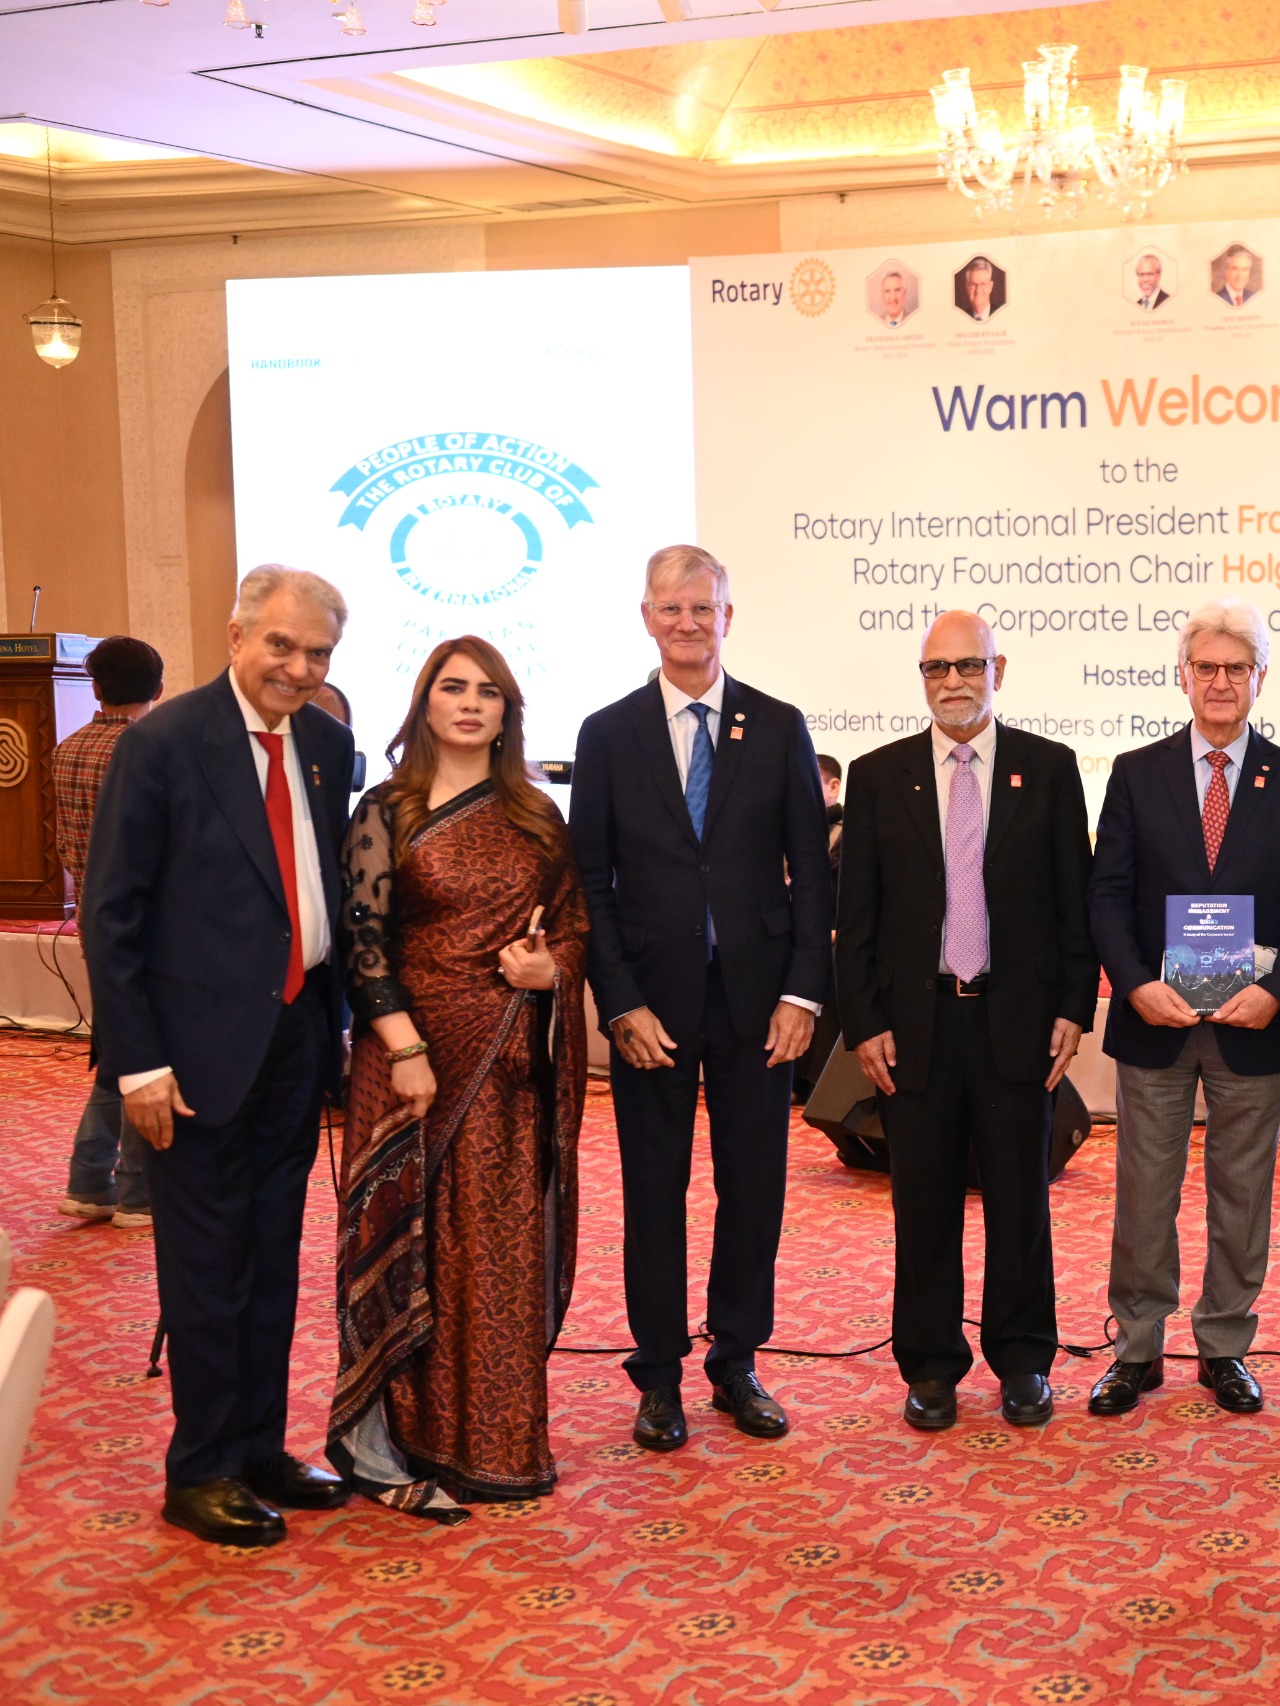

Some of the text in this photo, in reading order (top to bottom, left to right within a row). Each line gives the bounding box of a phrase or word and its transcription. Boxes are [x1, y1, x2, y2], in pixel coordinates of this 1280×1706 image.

[711, 279, 784, 306] Rotary
[251, 358, 322, 370] HANDBOOK
[932, 384, 1088, 432] Warm
[356, 433, 573, 477] PEOPLE OF ACTION
[1100, 457, 1178, 483] to the
[356, 456, 574, 510] THE ROTARY CLUB OF
[423, 494, 506, 514] ROTARY
[793, 512, 884, 545] Rotary
[890, 508, 1077, 538] International
[1086, 505, 1230, 537] President
[853, 558, 945, 591] Rotary
[953, 555, 1121, 584] Foundation
[1130, 553, 1213, 583] Chair
[859, 603, 913, 631] and
[976, 603, 1128, 637] Corporate
[1083, 664, 1166, 687] Hosted
[805, 708, 885, 732] esident
[1100, 714, 1124, 737] of
[1130, 715, 1187, 738] Rota
